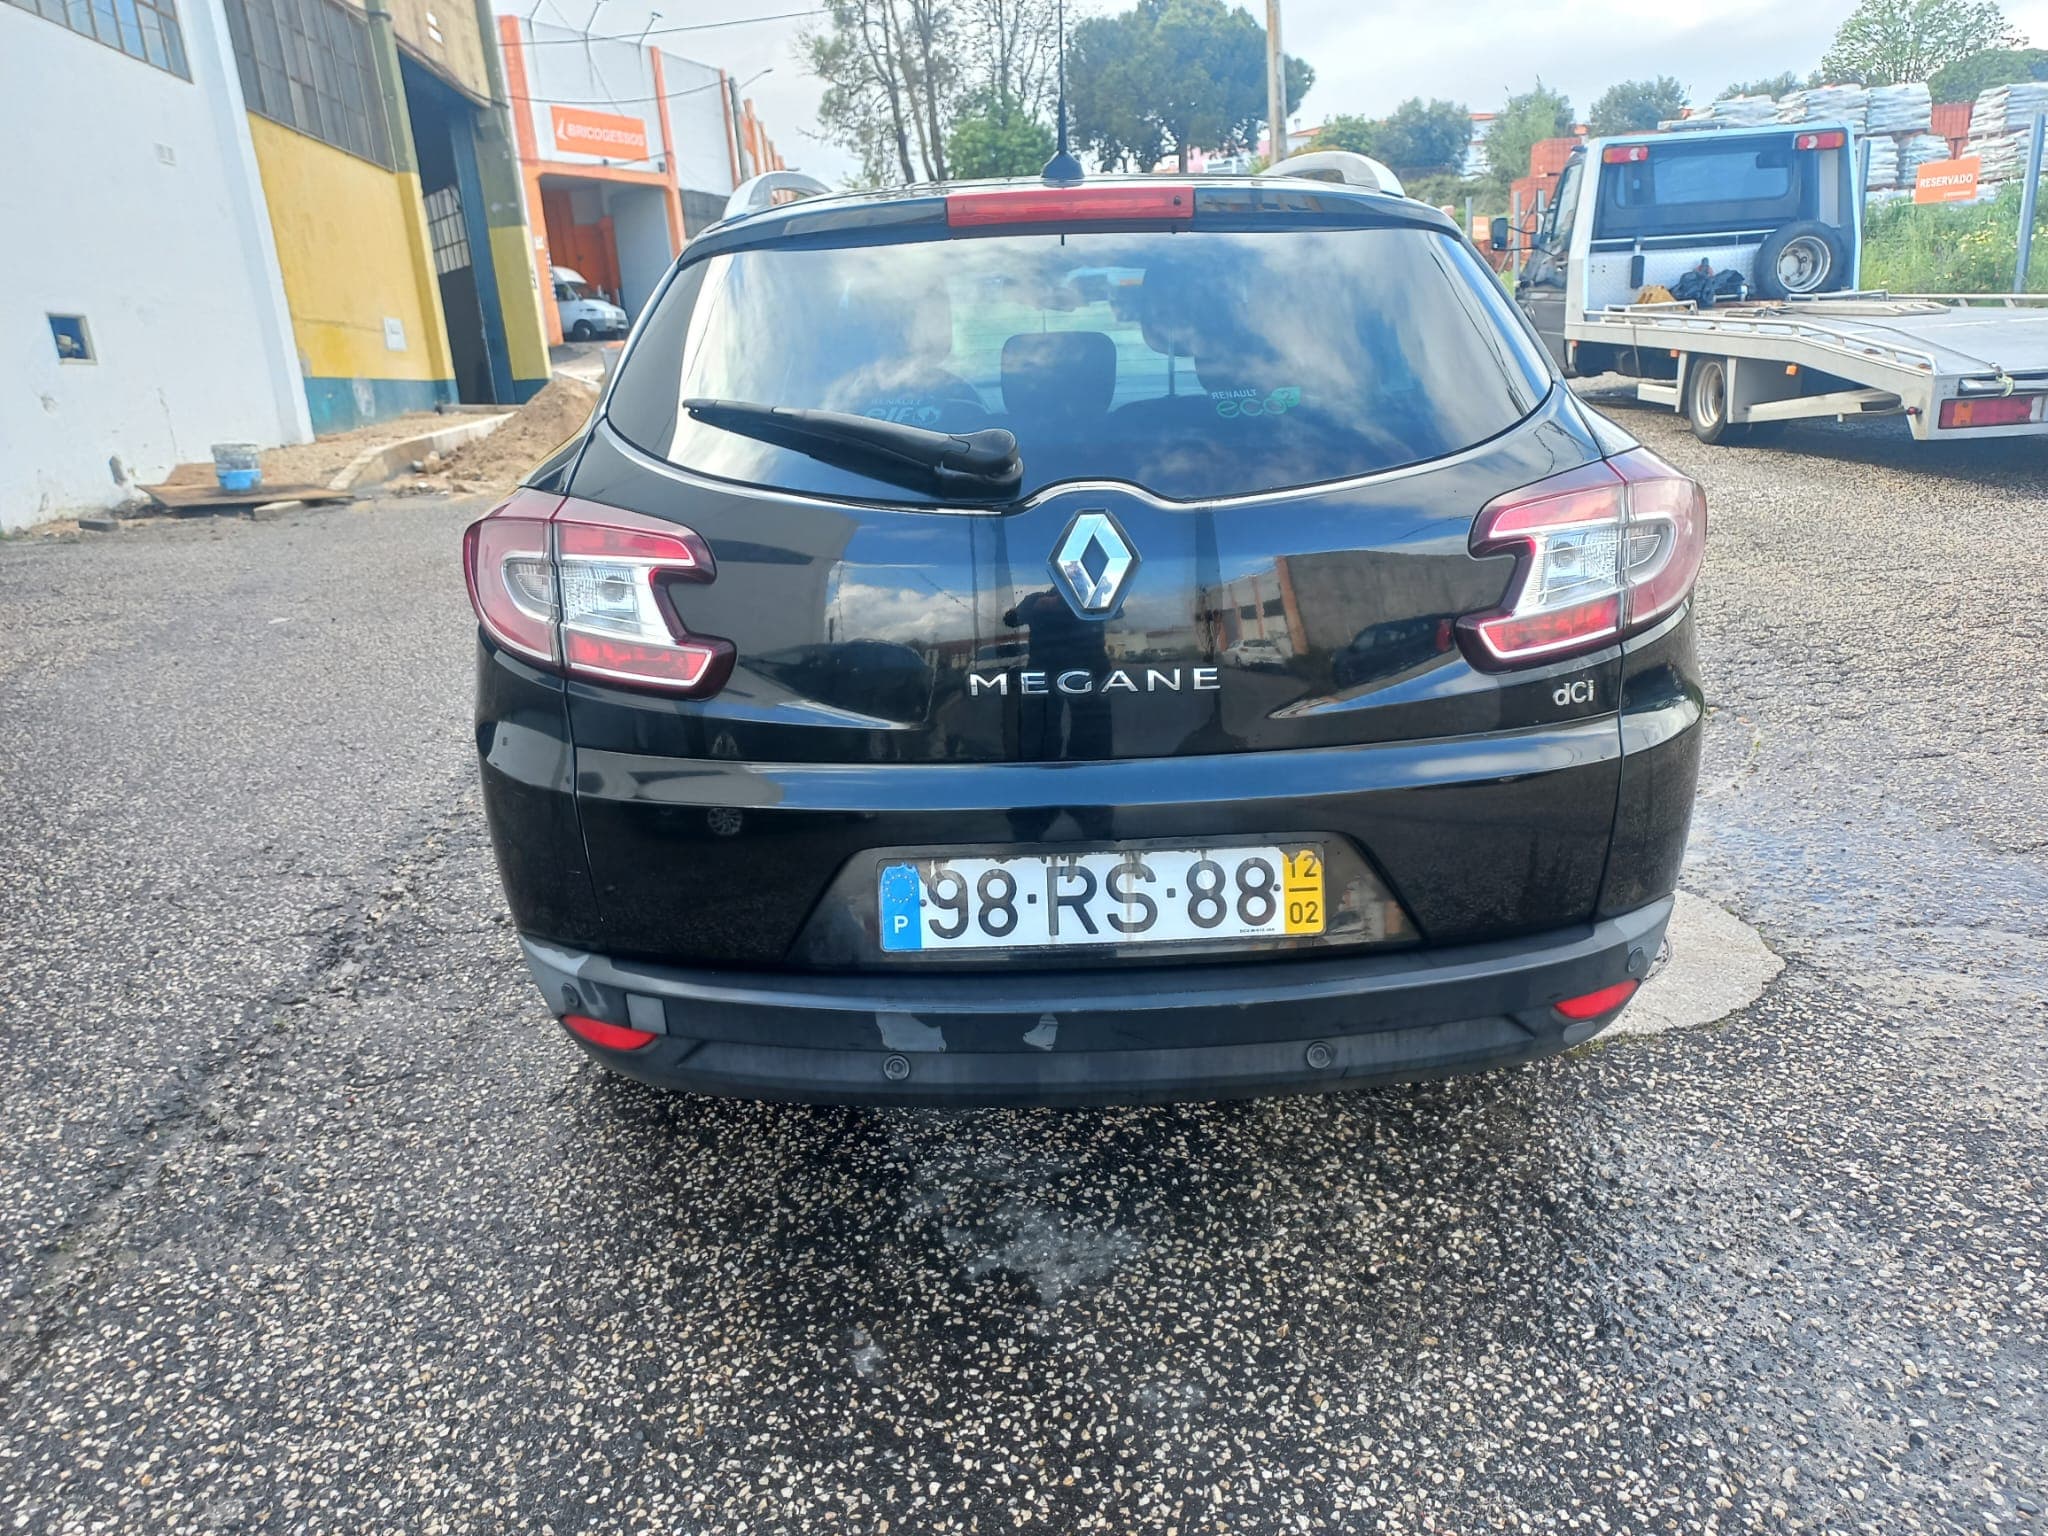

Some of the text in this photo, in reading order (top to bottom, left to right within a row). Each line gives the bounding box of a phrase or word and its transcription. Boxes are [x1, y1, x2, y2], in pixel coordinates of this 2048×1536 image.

[1920, 173, 1974, 189] RESERVADO
[1212, 389, 1257, 400] RENAULT
[969, 667, 1222, 697] MEGANE
[1552, 679, 1595, 706] dCi
[1289, 854, 1318, 879] 12
[893, 915, 909, 934] P
[1289, 900, 1320, 925] 02
